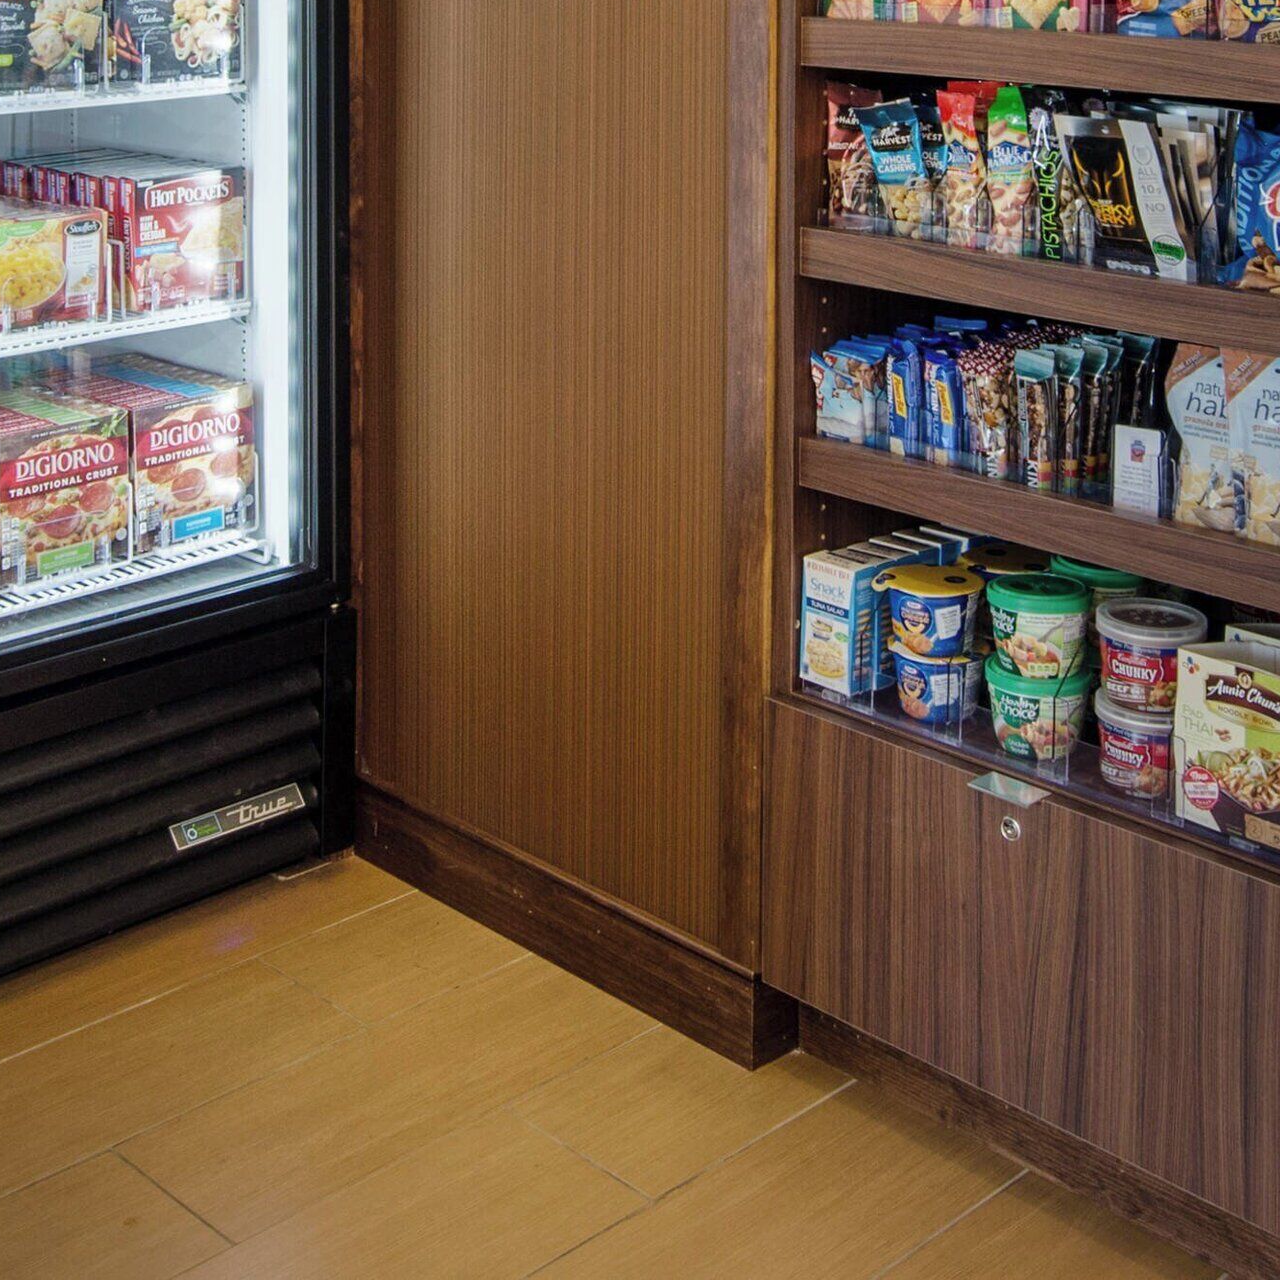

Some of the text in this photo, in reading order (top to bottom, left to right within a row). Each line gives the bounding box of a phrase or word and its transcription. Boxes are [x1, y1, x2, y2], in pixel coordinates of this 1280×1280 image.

[873, 134, 911, 147] HARVEST
[876, 163, 917, 174] CASHEWS
[879, 154, 912, 164] WHOLE
[150, 181, 230, 208] HOT POCKETS
[1040, 148, 1062, 261] PISTACHIOS
[1144, 203, 1166, 213] NO
[68, 221, 99, 235] Stouffer's
[1185, 393, 1227, 420] hab
[144, 445, 212, 466] TRADITIONAL
[987, 450, 999, 478] KIN
[9, 466, 119, 499] TRADITIONAL CRUST
[1026, 459, 1039, 488] KIN
[810, 578, 846, 600] Snack
[810, 600, 846, 617] TUNA SALAD
[1111, 659, 1158, 682] CHUNKY
[1207, 680, 1245, 700] Annie
[1000, 694, 1040, 712] Healthy
[1000, 702, 1037, 720] Choice
[1182, 715, 1214, 737] THAI
[1105, 744, 1144, 768] CHUNKY
